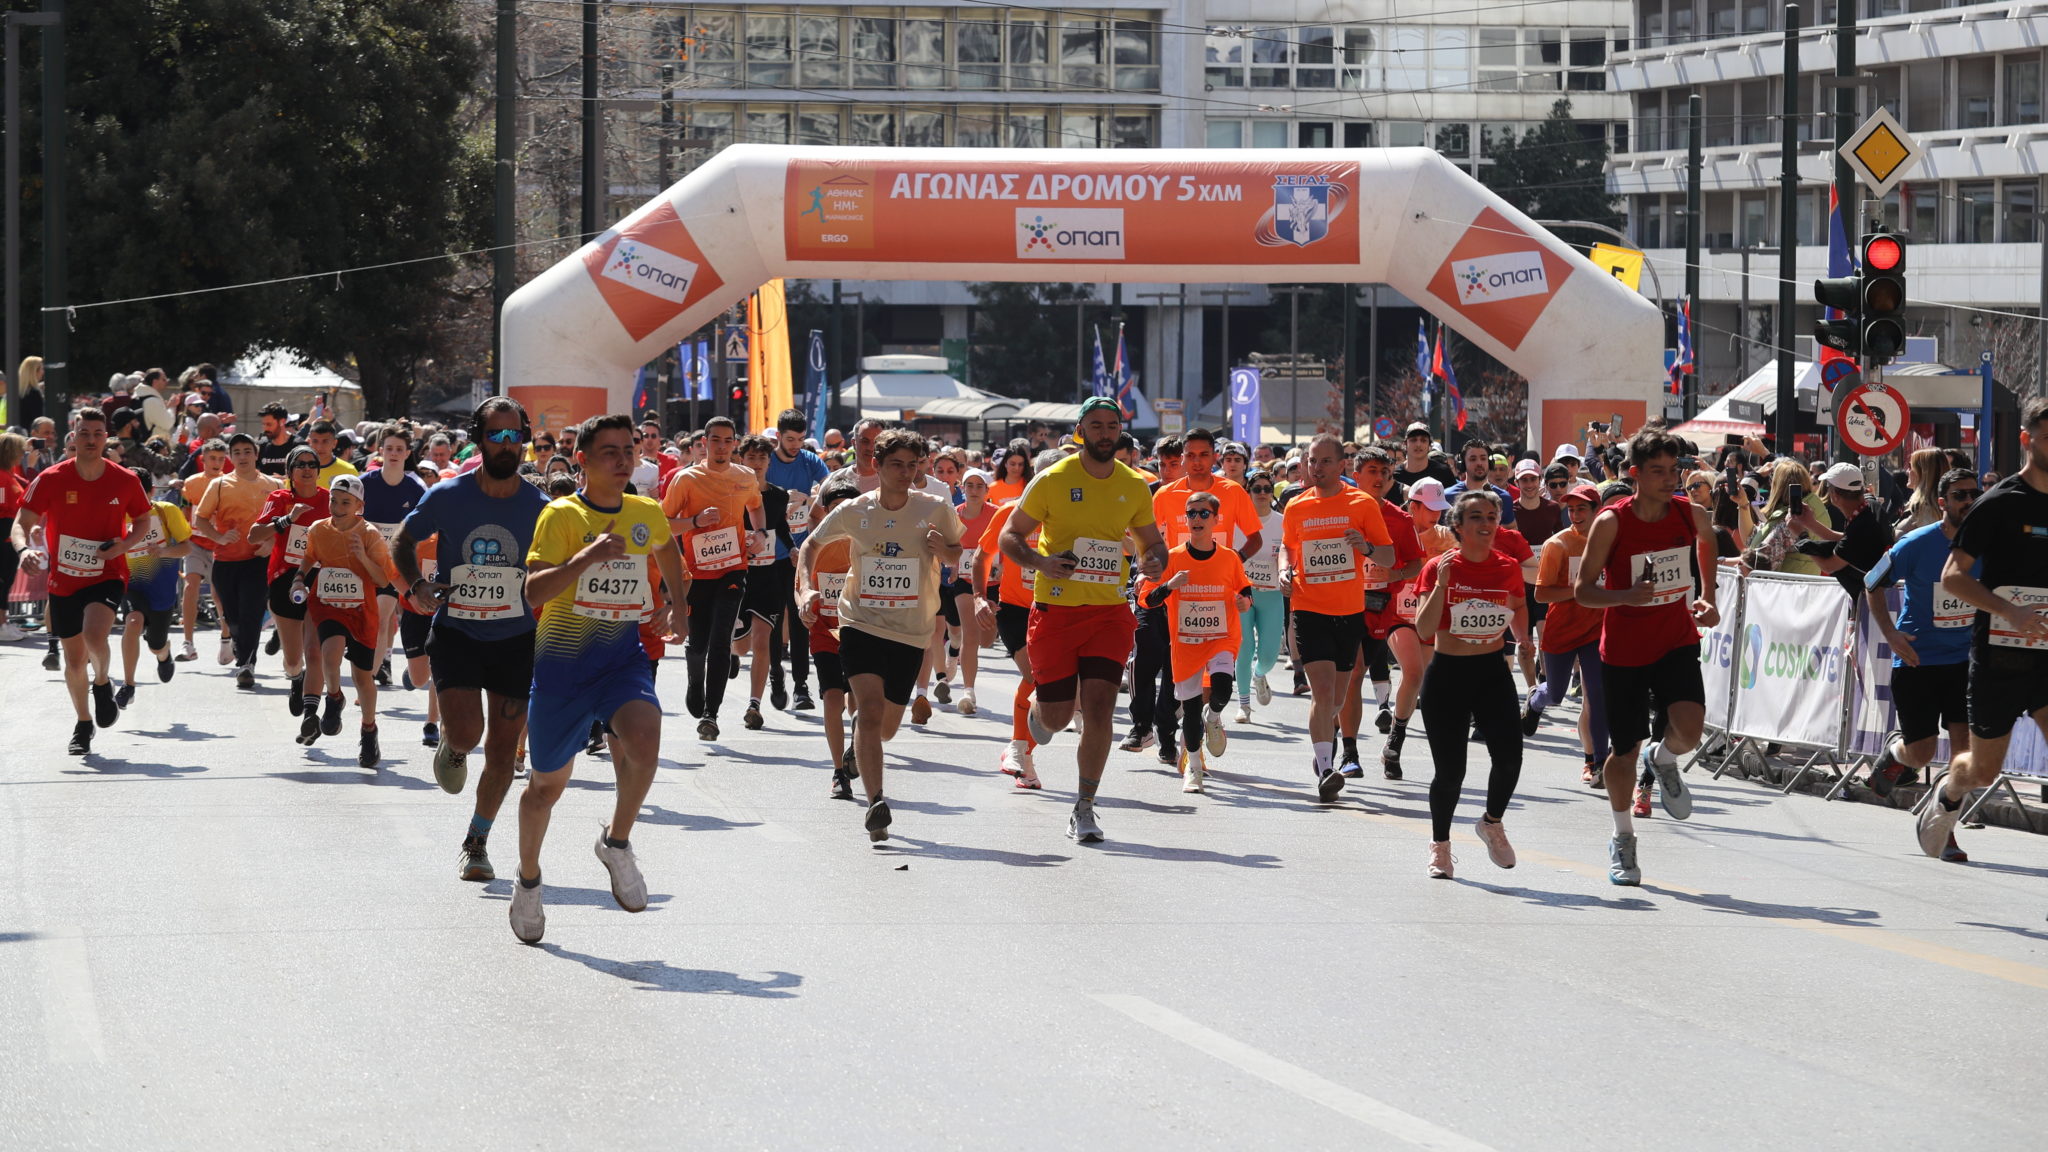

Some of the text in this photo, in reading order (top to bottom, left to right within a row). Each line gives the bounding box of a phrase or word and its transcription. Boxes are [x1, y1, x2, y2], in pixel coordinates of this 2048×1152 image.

[890, 173, 1242, 201] ΑΓΩΝΑΣ ΔΡΟΜΟΥ 5 ΧΛΜ
[1275, 174, 1329, 186] ΣΕΓΑΣ
[827, 189, 864, 198] ΑΘΗΝΑΣ
[821, 234, 848, 243] ERGO
[1236, 374, 1249, 402] 2
[1302, 516, 1350, 528] whitestone
[294, 539, 308, 550] 63
[701, 541, 732, 557] 64647
[64, 550, 98, 565] 63735
[1080, 556, 1118, 571] 63306
[1309, 553, 1347, 567] 64086
[868, 575, 911, 589] 63170
[1651, 567, 1680, 584] 4131
[323, 582, 357, 593] 64615
[459, 583, 505, 599] 63719
[588, 578, 638, 595] 64377
[1404, 598, 1417, 608] 64
[1184, 616, 1220, 628] 64098
[1460, 614, 1506, 628] 63035
[1764, 641, 1840, 684] COSMOTE
